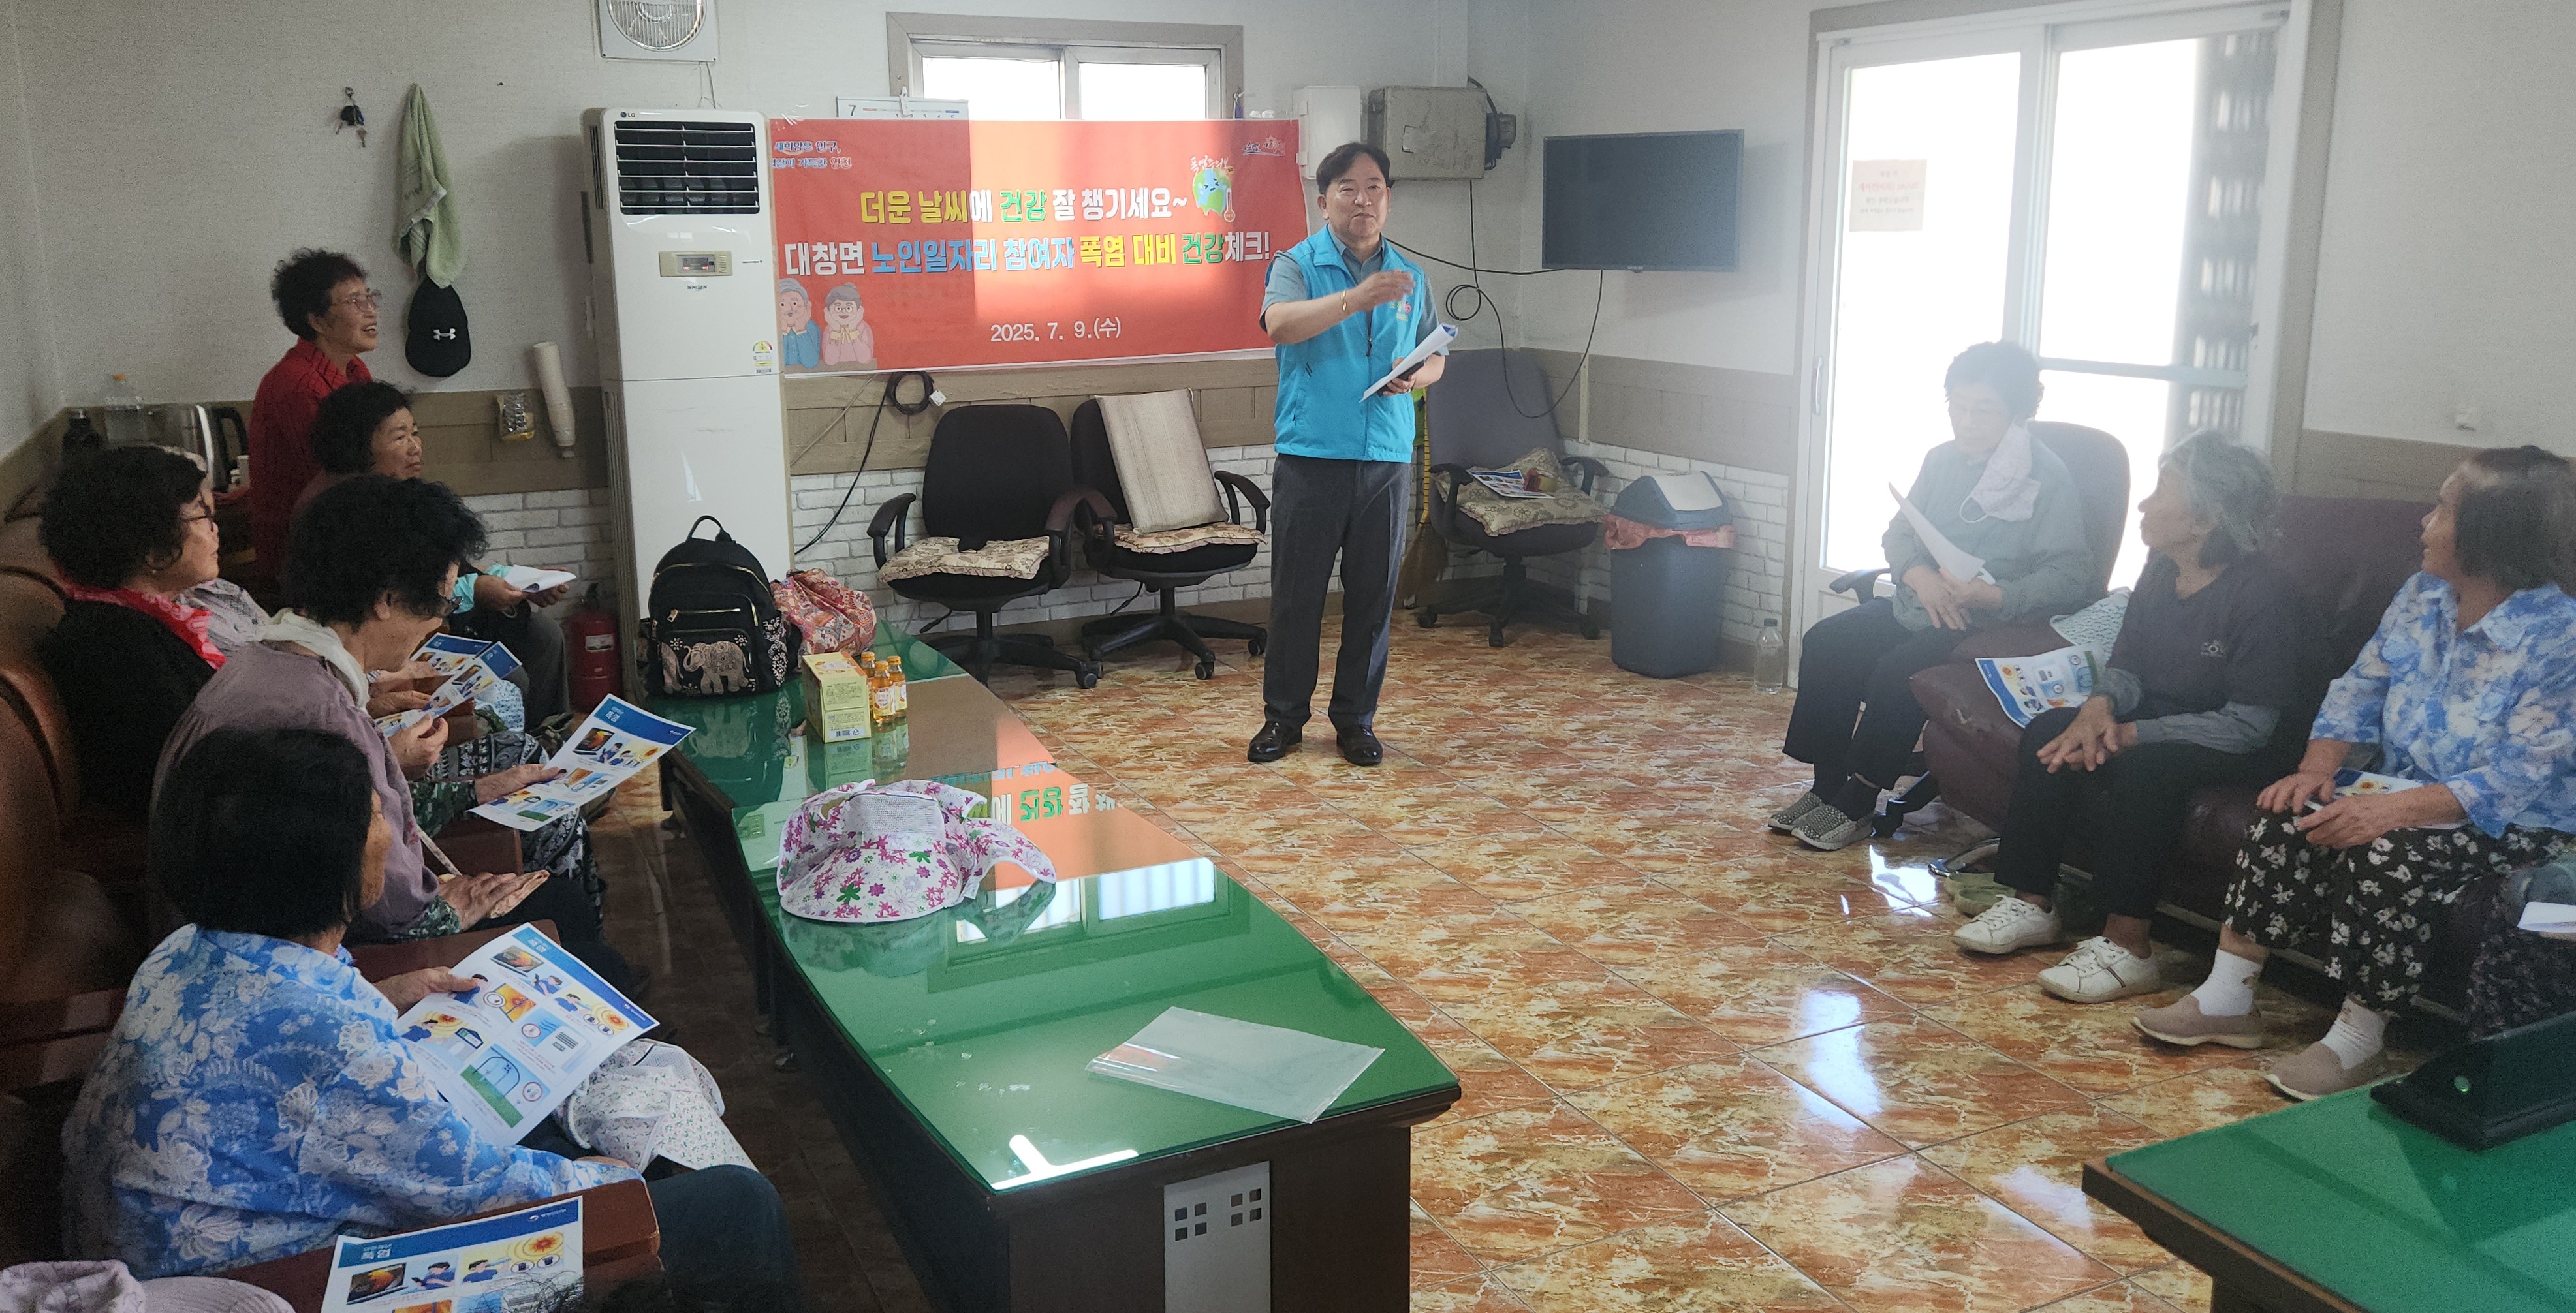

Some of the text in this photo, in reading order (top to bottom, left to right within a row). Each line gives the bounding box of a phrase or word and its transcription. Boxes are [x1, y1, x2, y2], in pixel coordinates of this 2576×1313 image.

[849, 104, 856, 116] 7
[815, 140, 841, 154] 인구,
[860, 187, 1188, 224] 더운 날씨에 건강 잘 챙기세요~
[784, 230, 1270, 276] 대창면 노인일자리 참여자 폭염 대비 건강체크!
[990, 323, 1040, 342] 2025.
[1046, 322, 1063, 340] 7.
